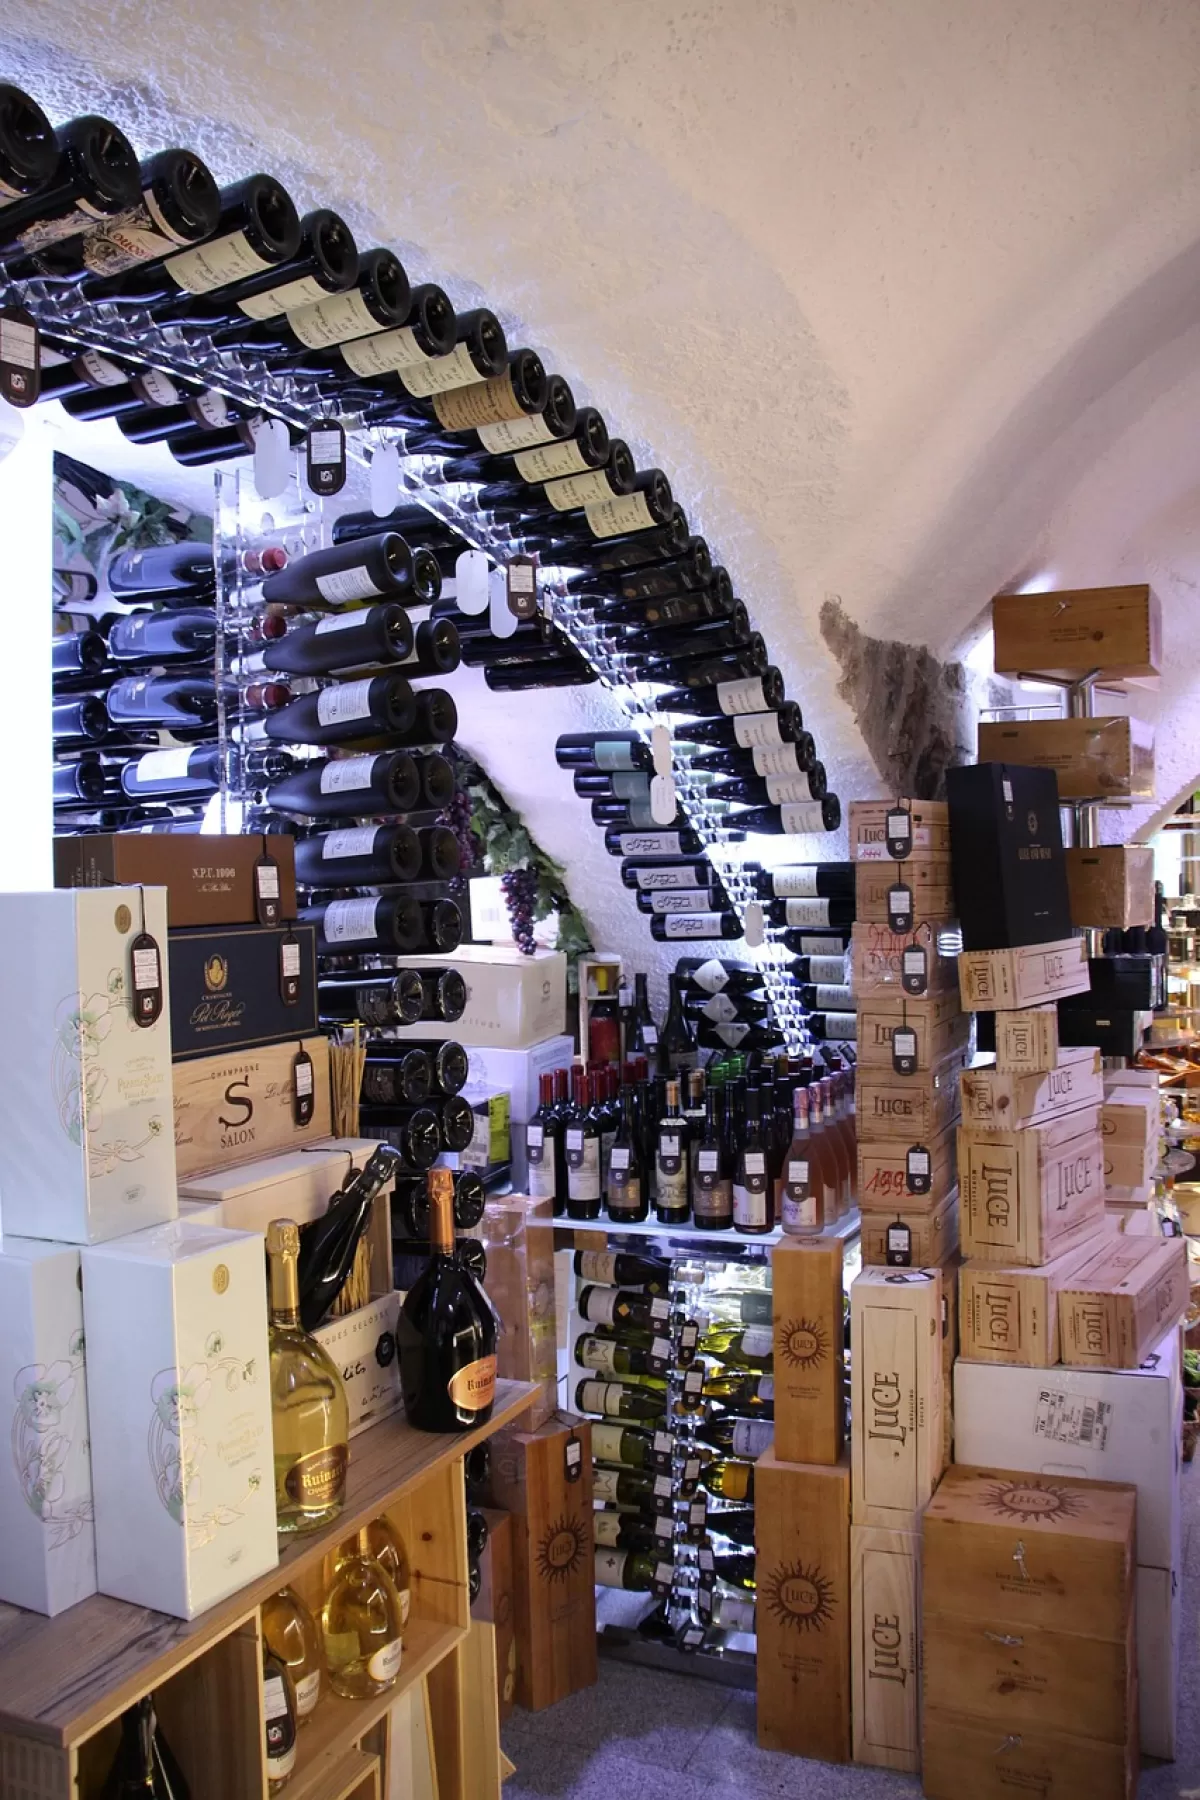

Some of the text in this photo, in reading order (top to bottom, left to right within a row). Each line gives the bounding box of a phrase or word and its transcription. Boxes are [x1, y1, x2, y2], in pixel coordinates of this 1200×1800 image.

[864, 828, 887, 844] LUC
[211, 1062, 260, 1080] CHAMPAGNE
[218, 1073, 253, 1132] S
[872, 1096, 913, 1117] LUCE
[220, 1127, 256, 1149] SALON
[982, 1162, 1013, 1228] LUCE
[1056, 1156, 1093, 1211] LUCE
[986, 1291, 1012, 1343] LUCE
[1082, 1308, 1104, 1351] LUCE
[868, 1371, 907, 1448] LUCE
[868, 1612, 907, 1689] LUCE
